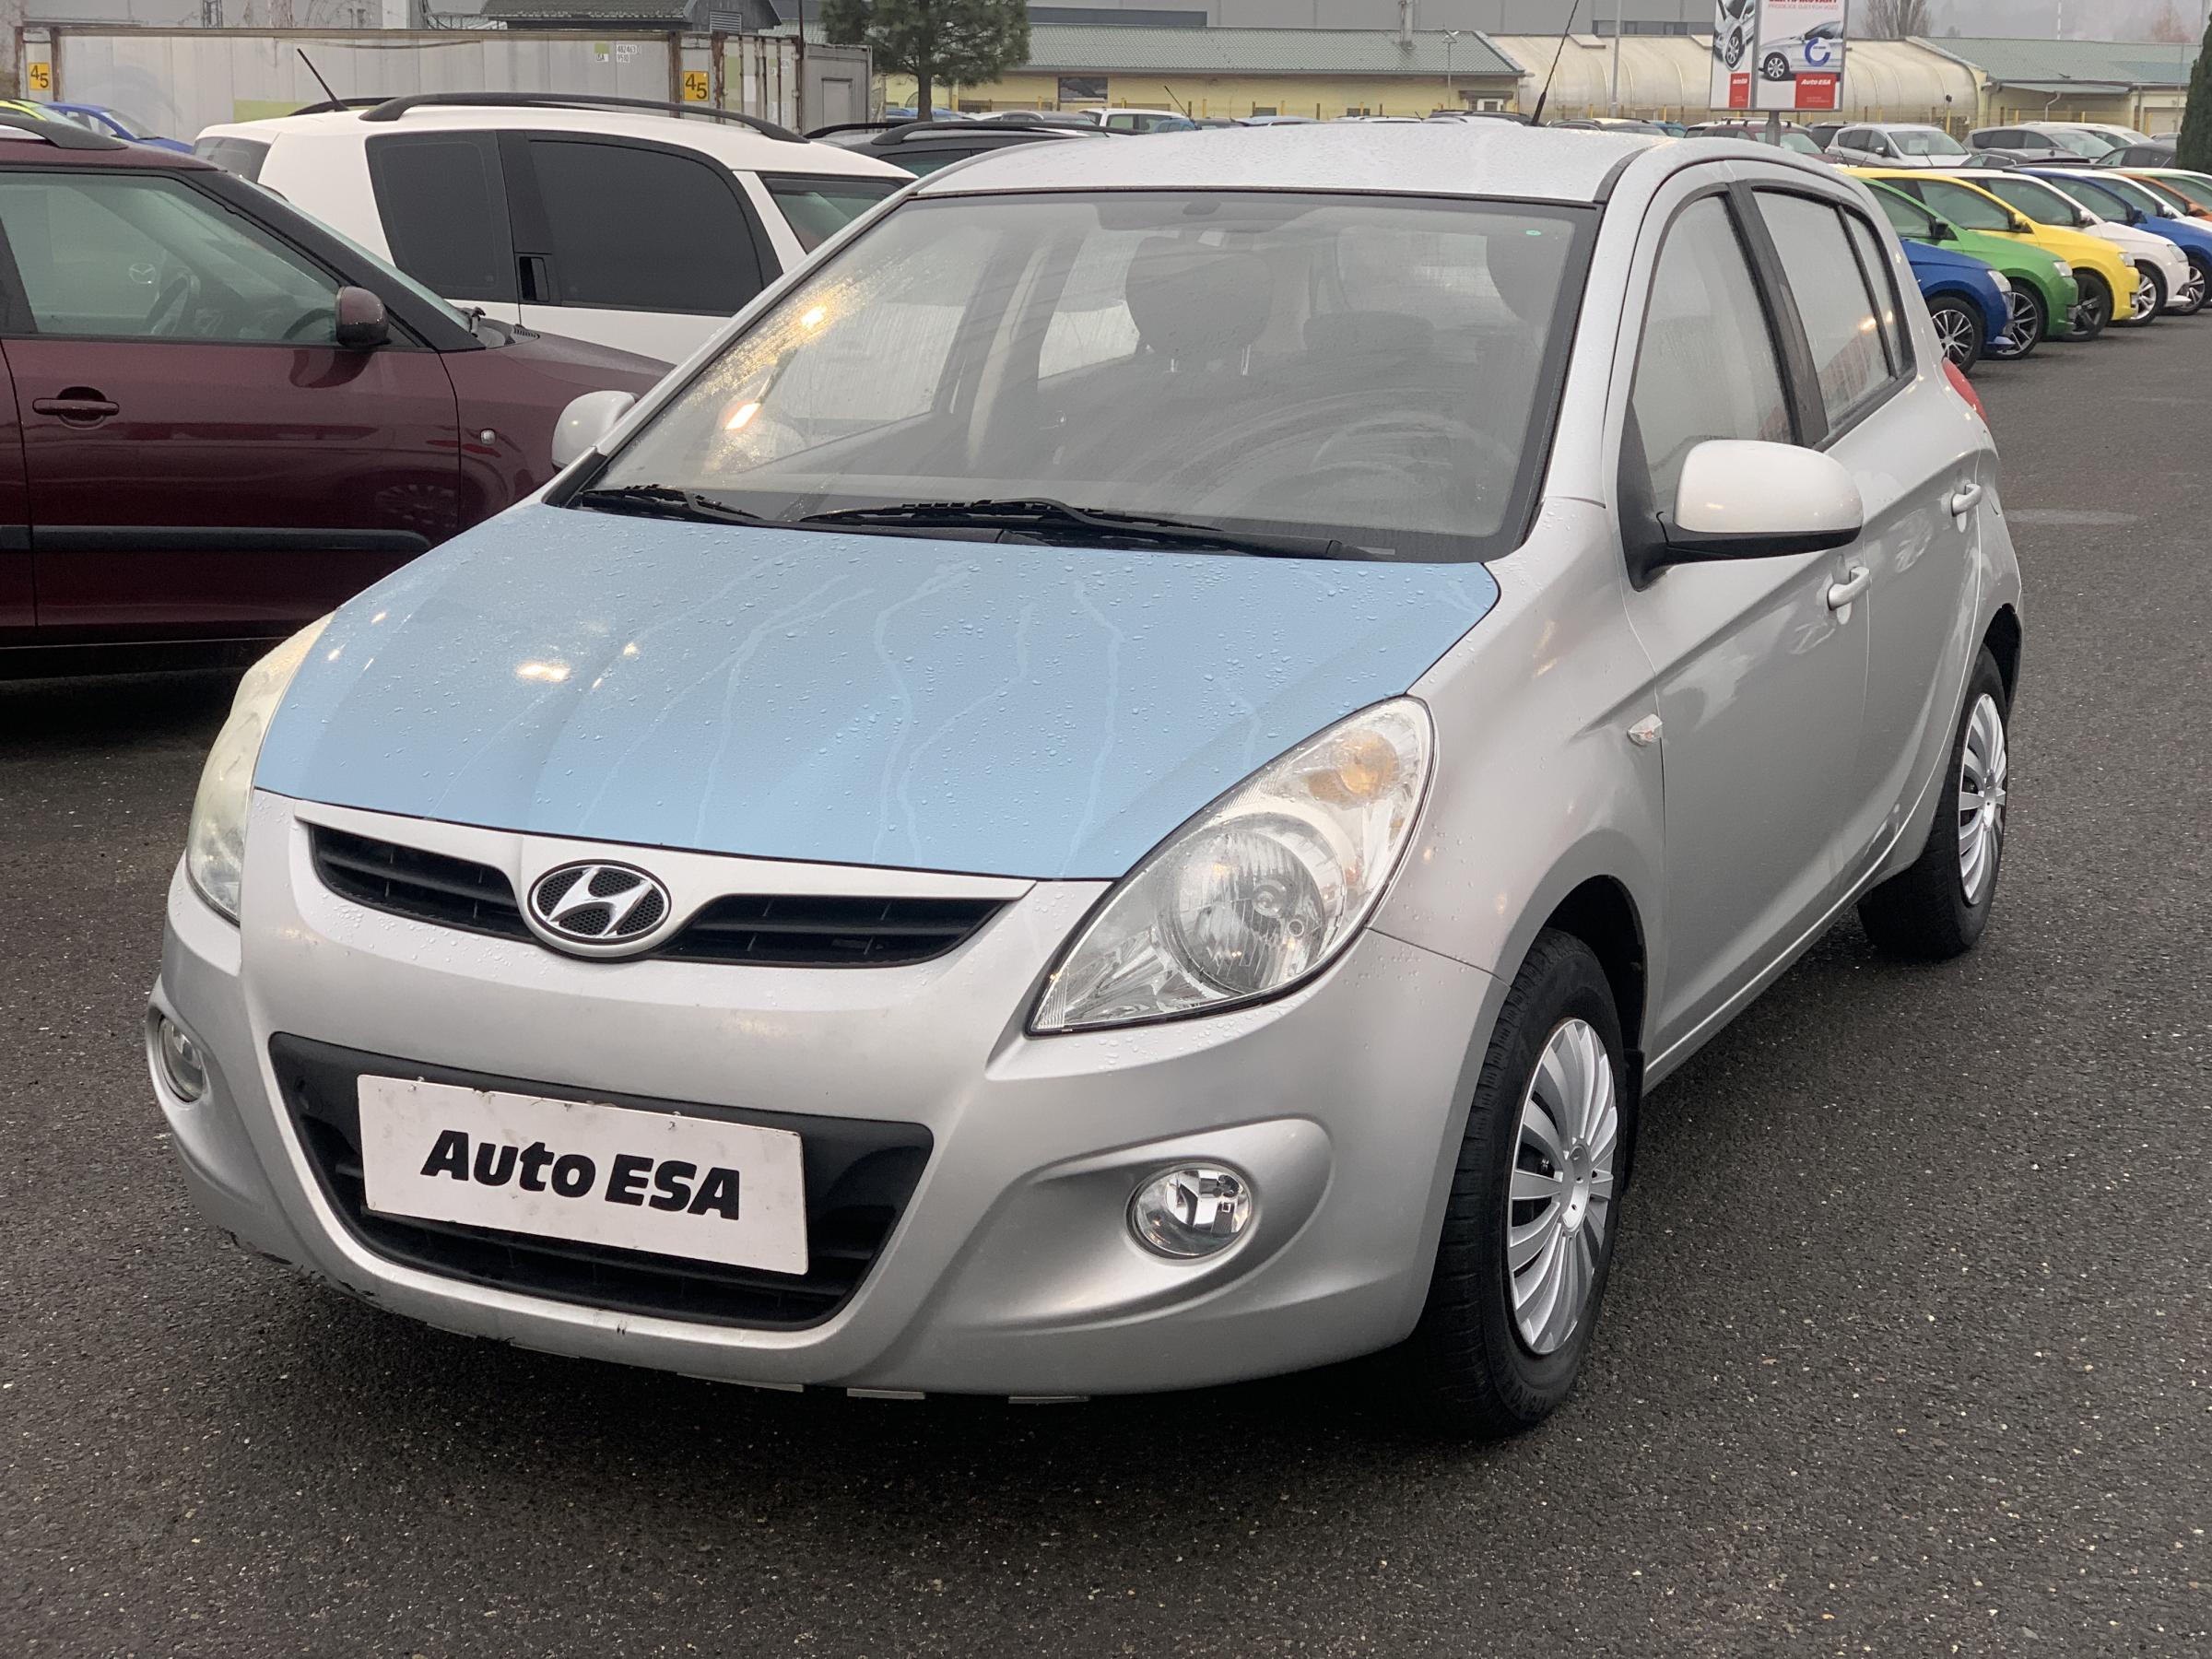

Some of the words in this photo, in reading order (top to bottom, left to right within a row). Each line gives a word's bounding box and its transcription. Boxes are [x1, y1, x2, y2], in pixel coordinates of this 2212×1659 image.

[30, 65, 49, 88] 45
[685, 74, 707, 100] 45
[419, 1130, 596, 1198] Auto
[605, 1153, 740, 1221] ESA
